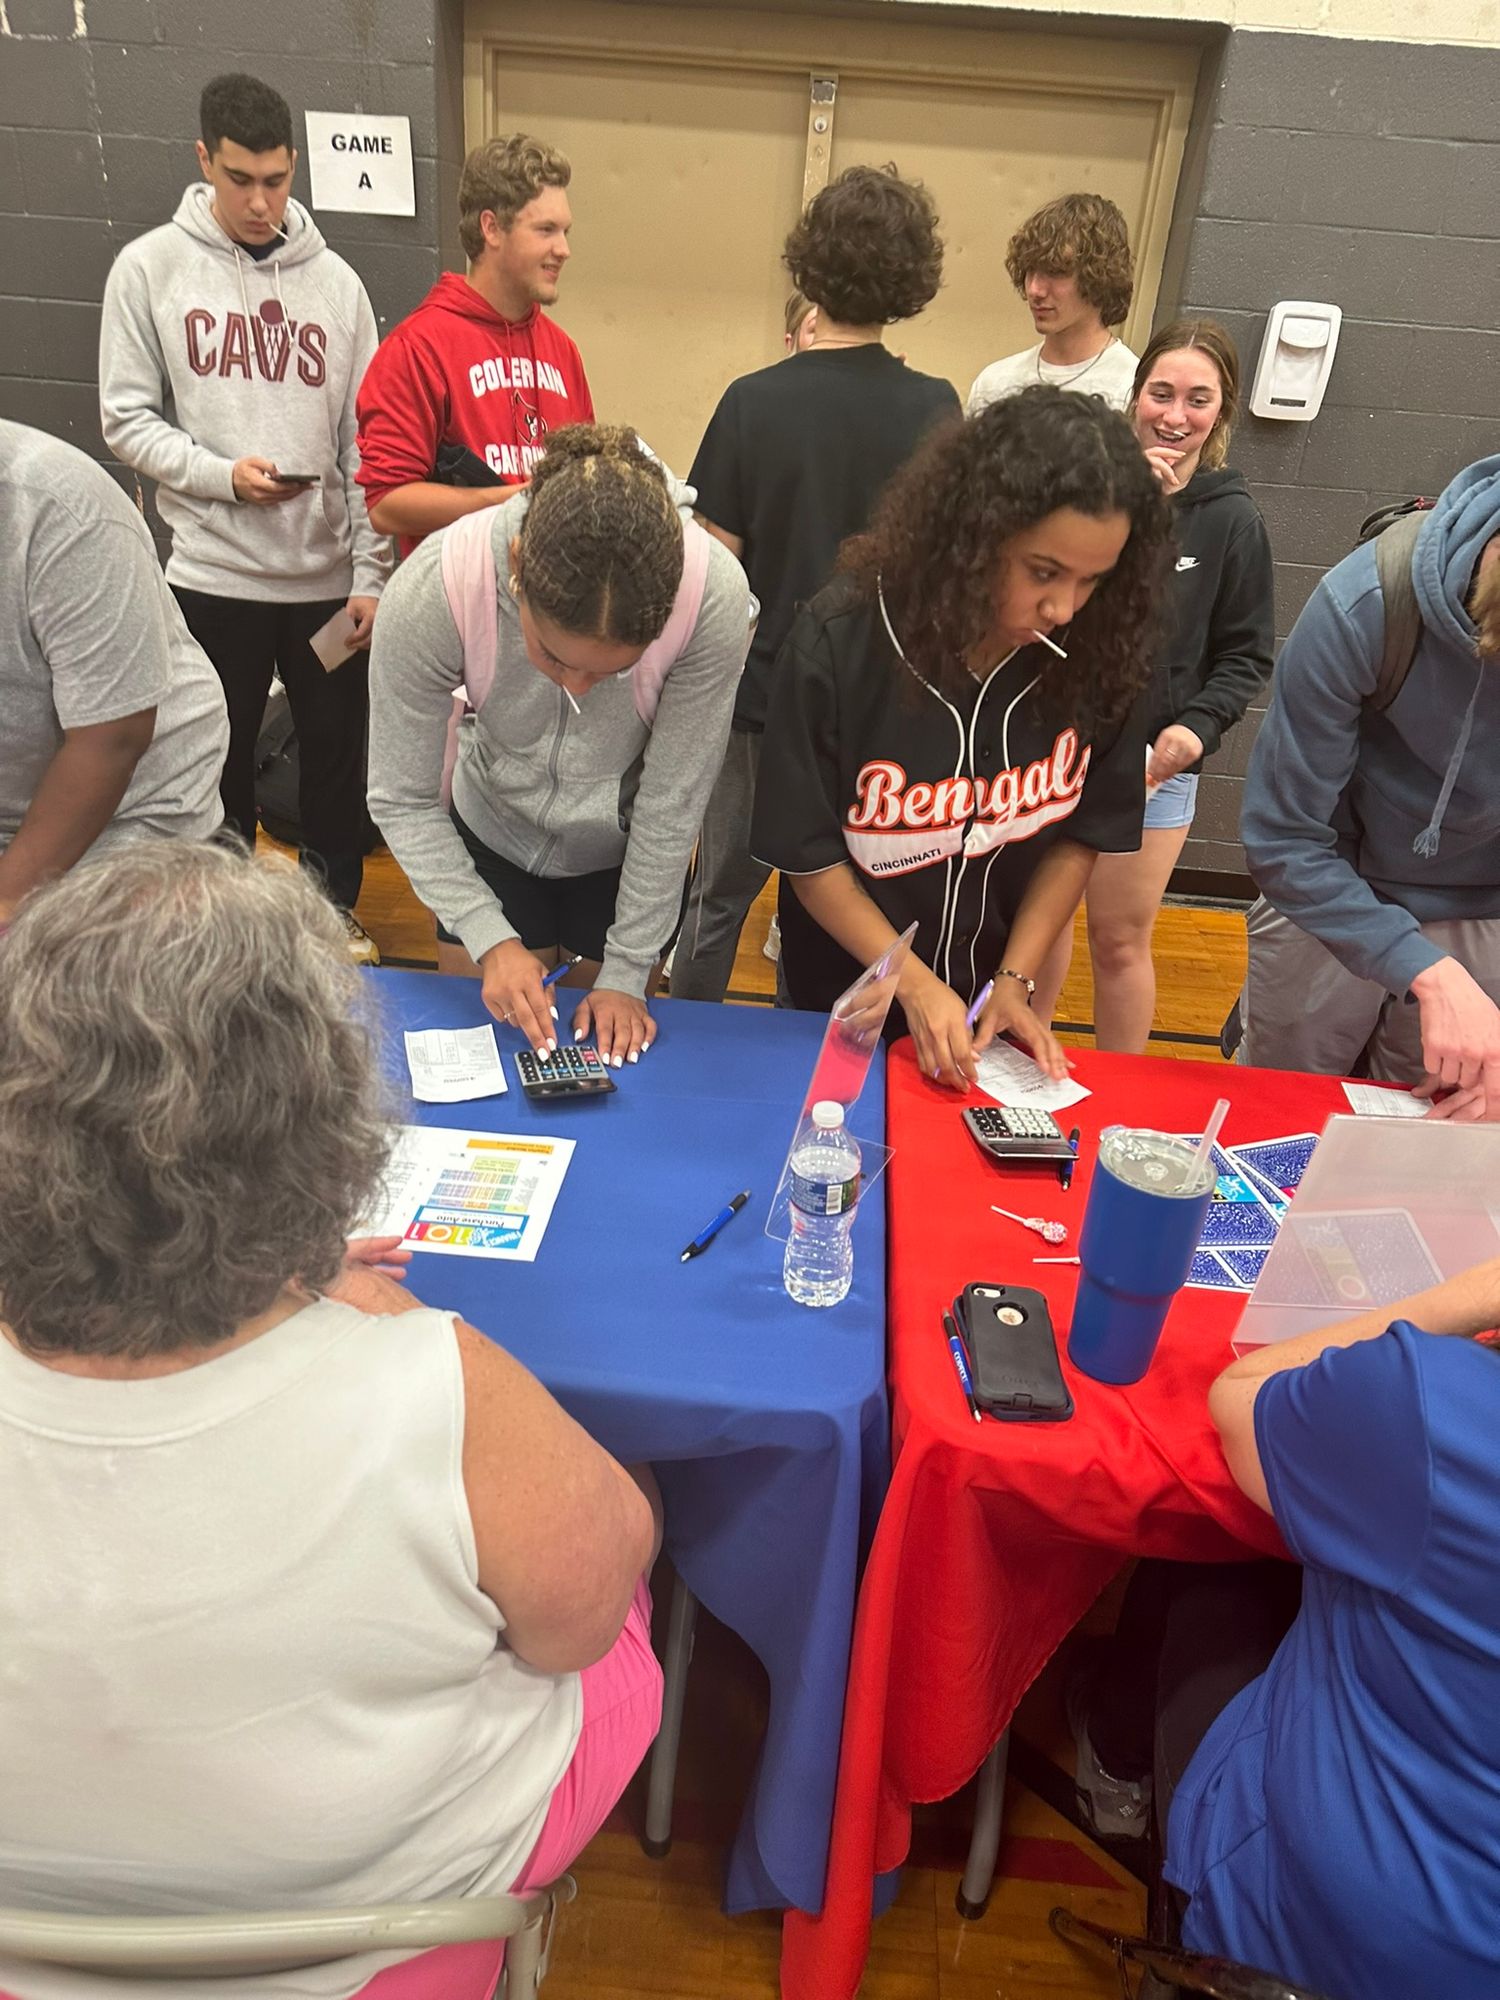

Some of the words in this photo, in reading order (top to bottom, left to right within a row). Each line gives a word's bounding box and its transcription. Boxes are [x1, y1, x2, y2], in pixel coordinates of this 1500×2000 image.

[331, 134, 393, 155] GAME
[358, 172, 373, 190] A
[184, 308, 327, 388] CAVS
[469, 356, 568, 399] COLERAIN
[871, 847, 942, 873] CINCINNATI
